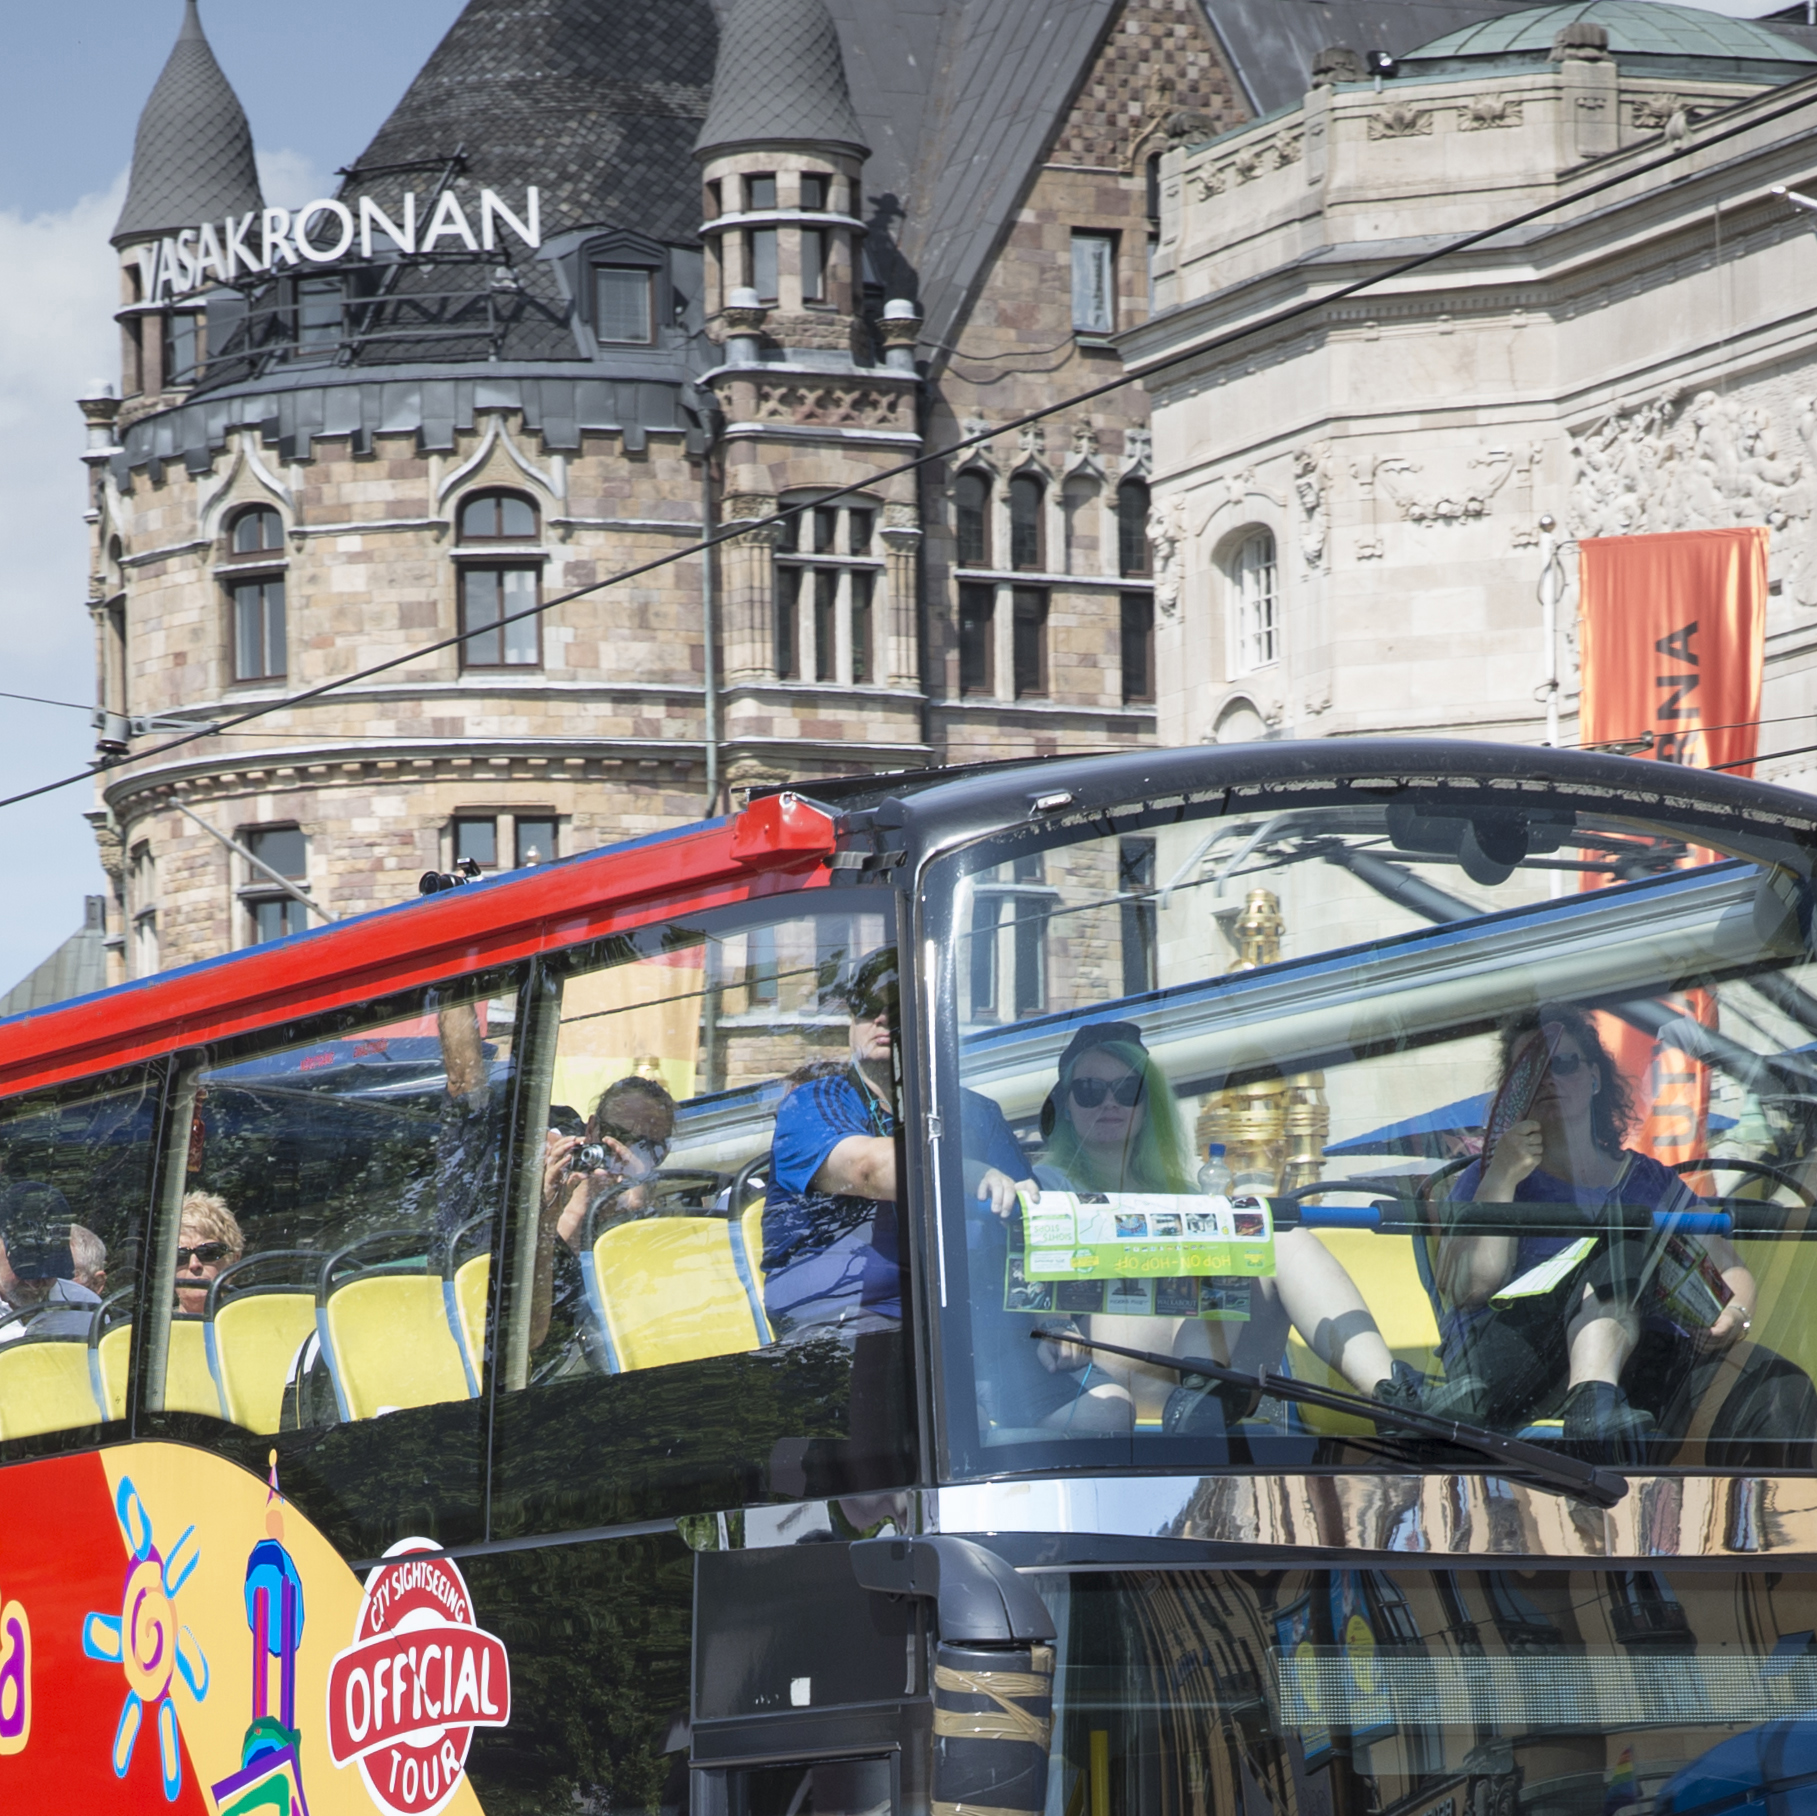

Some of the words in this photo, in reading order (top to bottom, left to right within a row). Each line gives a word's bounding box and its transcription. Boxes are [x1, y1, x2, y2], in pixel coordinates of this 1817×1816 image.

[135, 185, 541, 306] VASAKRONAN
[1655, 620, 1700, 766] RNA
[391, 1561, 467, 1623] SIGHTSEEING
[345, 1644, 500, 1743] OFFICIAL
[388, 1738, 461, 1805] TOUR
